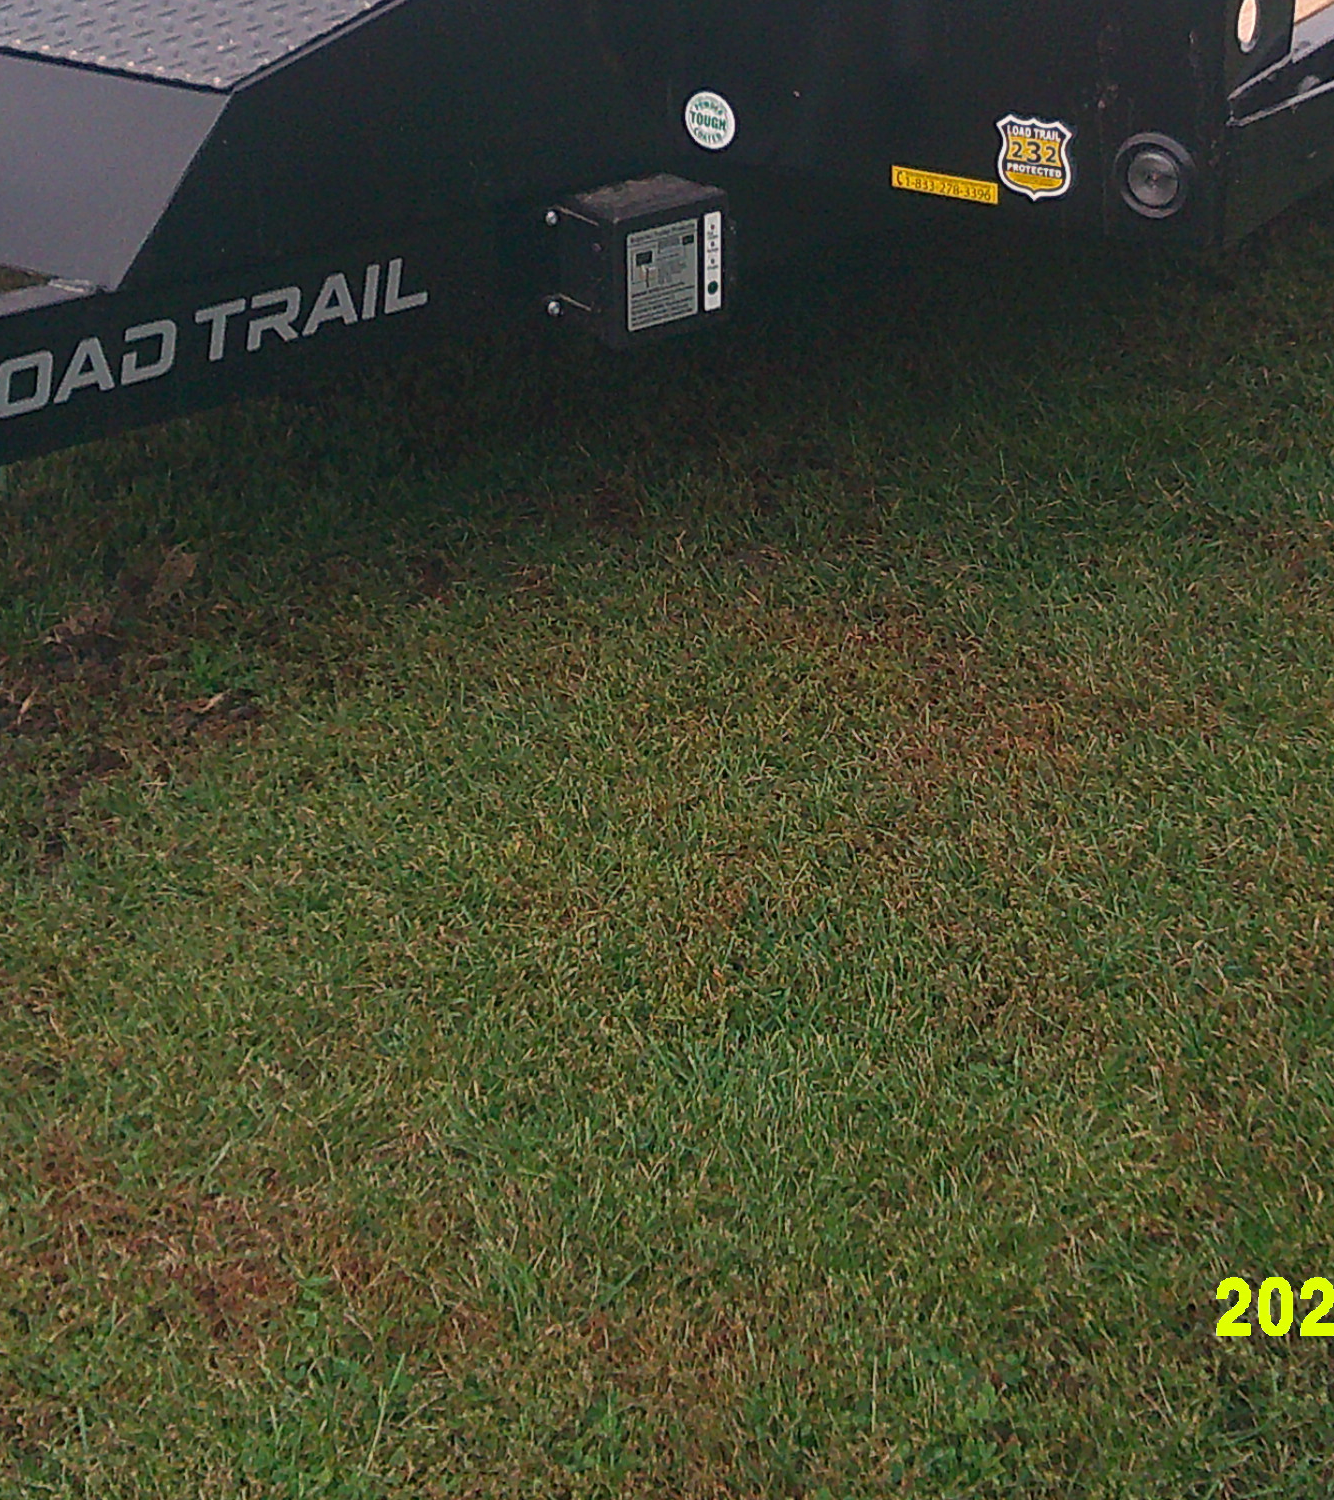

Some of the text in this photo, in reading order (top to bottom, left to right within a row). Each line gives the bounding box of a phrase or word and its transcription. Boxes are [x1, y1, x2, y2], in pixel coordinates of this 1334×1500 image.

[690, 110, 727, 132] TOUGH
[1007, 124, 1062, 142] LOAD TRAIL
[1012, 141, 1057, 163] 232
[1006, 162, 1062, 178] PROTECTED
[194, 257, 429, 362] TRAIL
